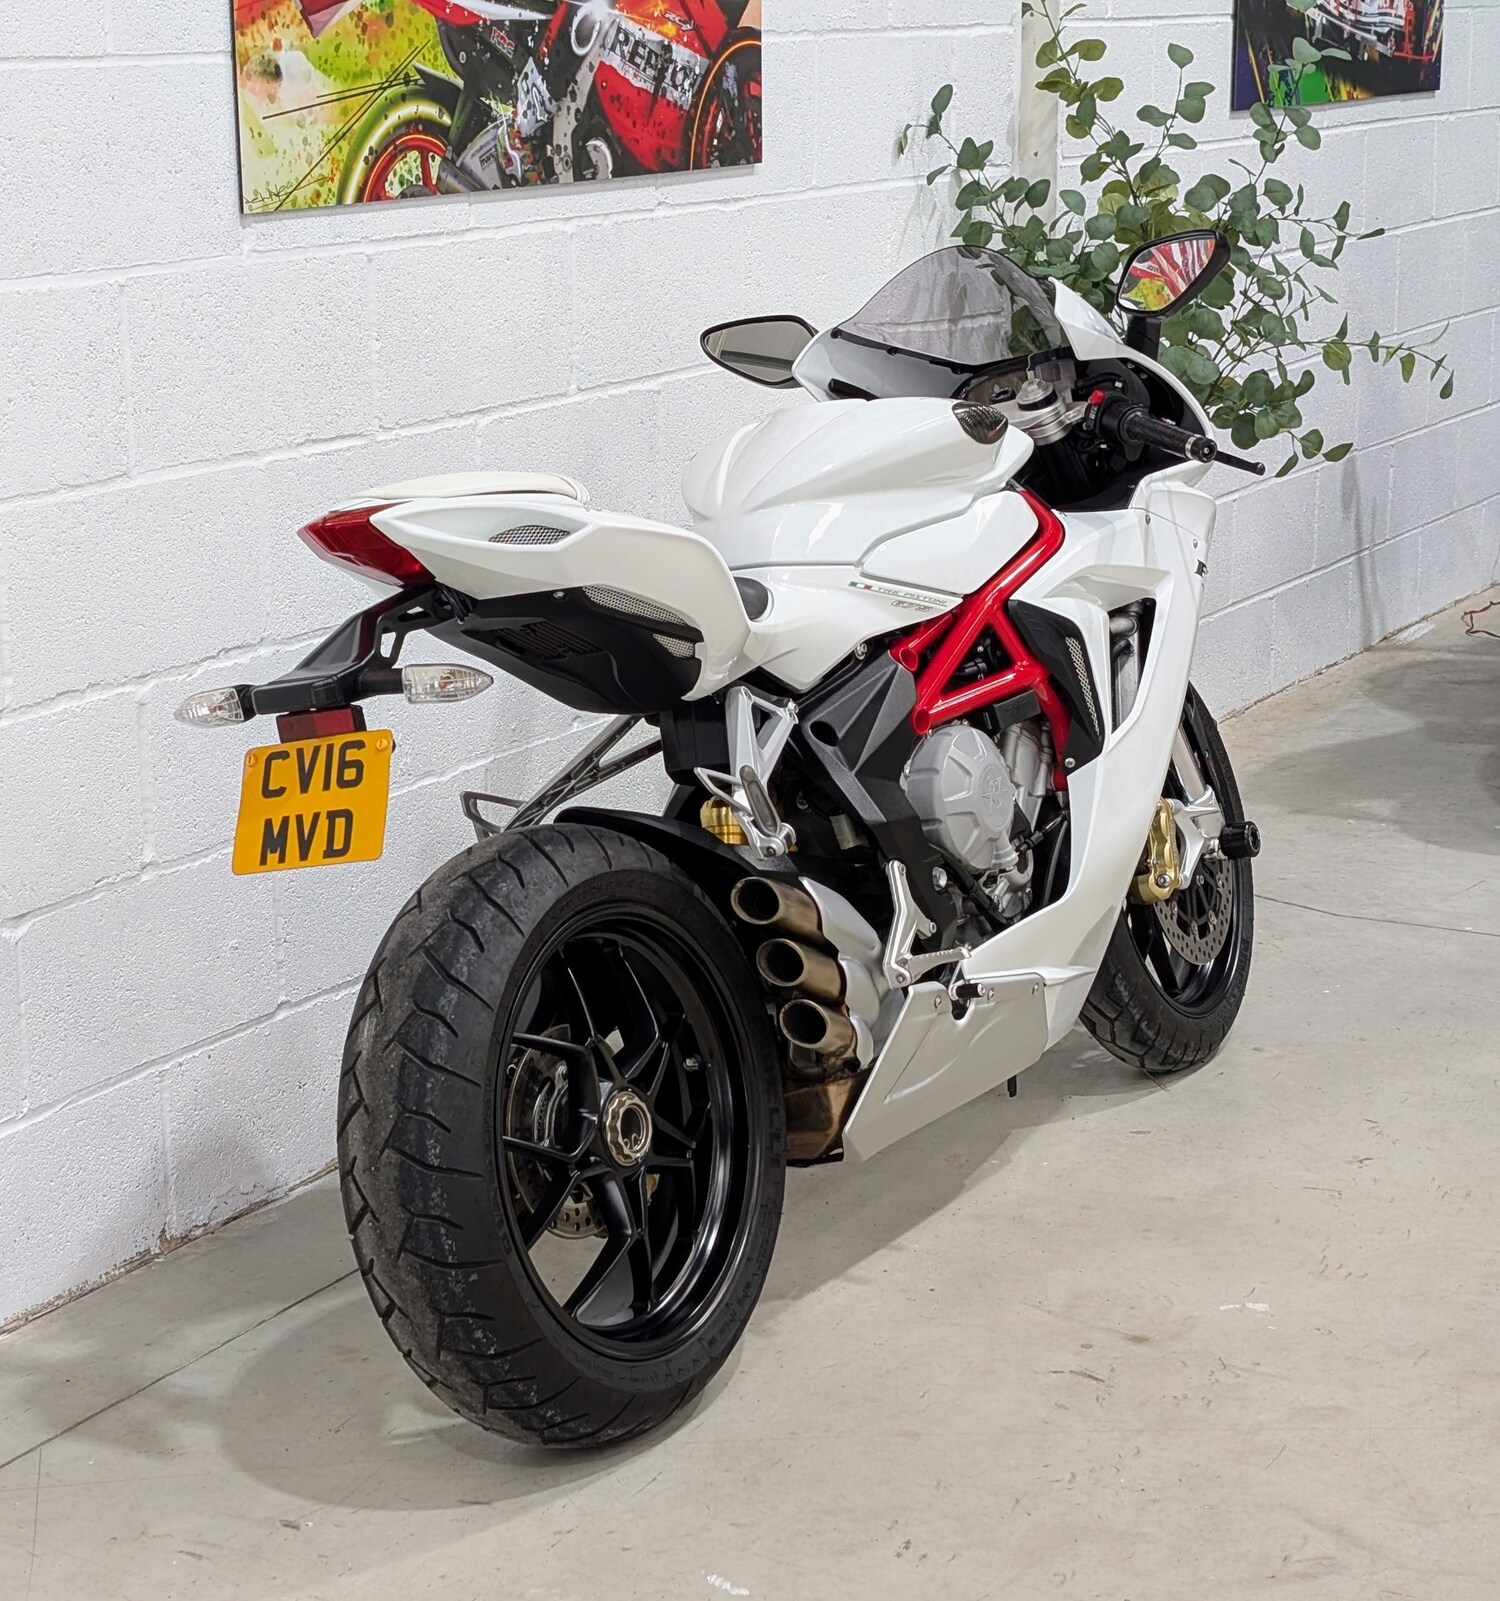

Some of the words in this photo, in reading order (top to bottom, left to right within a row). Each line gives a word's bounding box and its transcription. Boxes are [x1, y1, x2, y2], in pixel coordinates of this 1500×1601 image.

[608, 24, 702, 93] REPO
[876, 586, 901, 595] TRE
[903, 592, 947, 604] PISTONI
[261, 739, 366, 799] CV16
[259, 808, 354, 866] MVD
